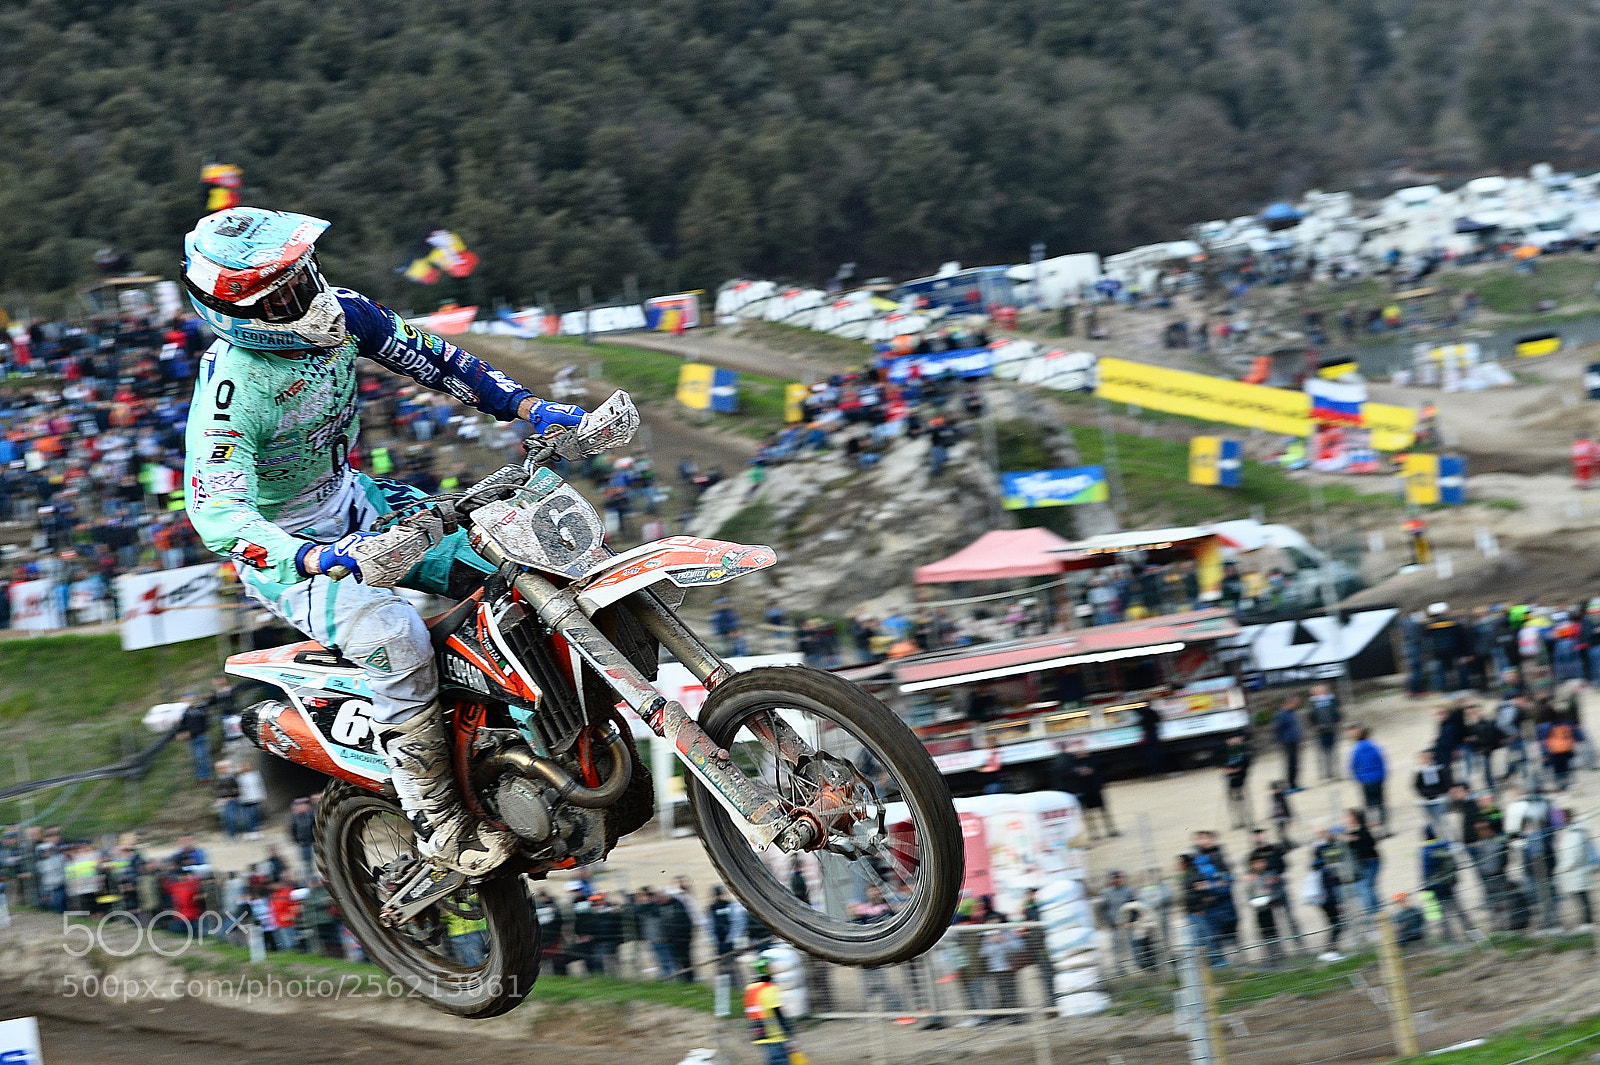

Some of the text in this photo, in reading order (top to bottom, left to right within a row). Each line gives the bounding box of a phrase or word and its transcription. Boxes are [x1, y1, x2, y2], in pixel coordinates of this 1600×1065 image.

[234, 329, 295, 347] LEOPARD
[532, 494, 594, 566] 6
[331, 699, 373, 746] 6
